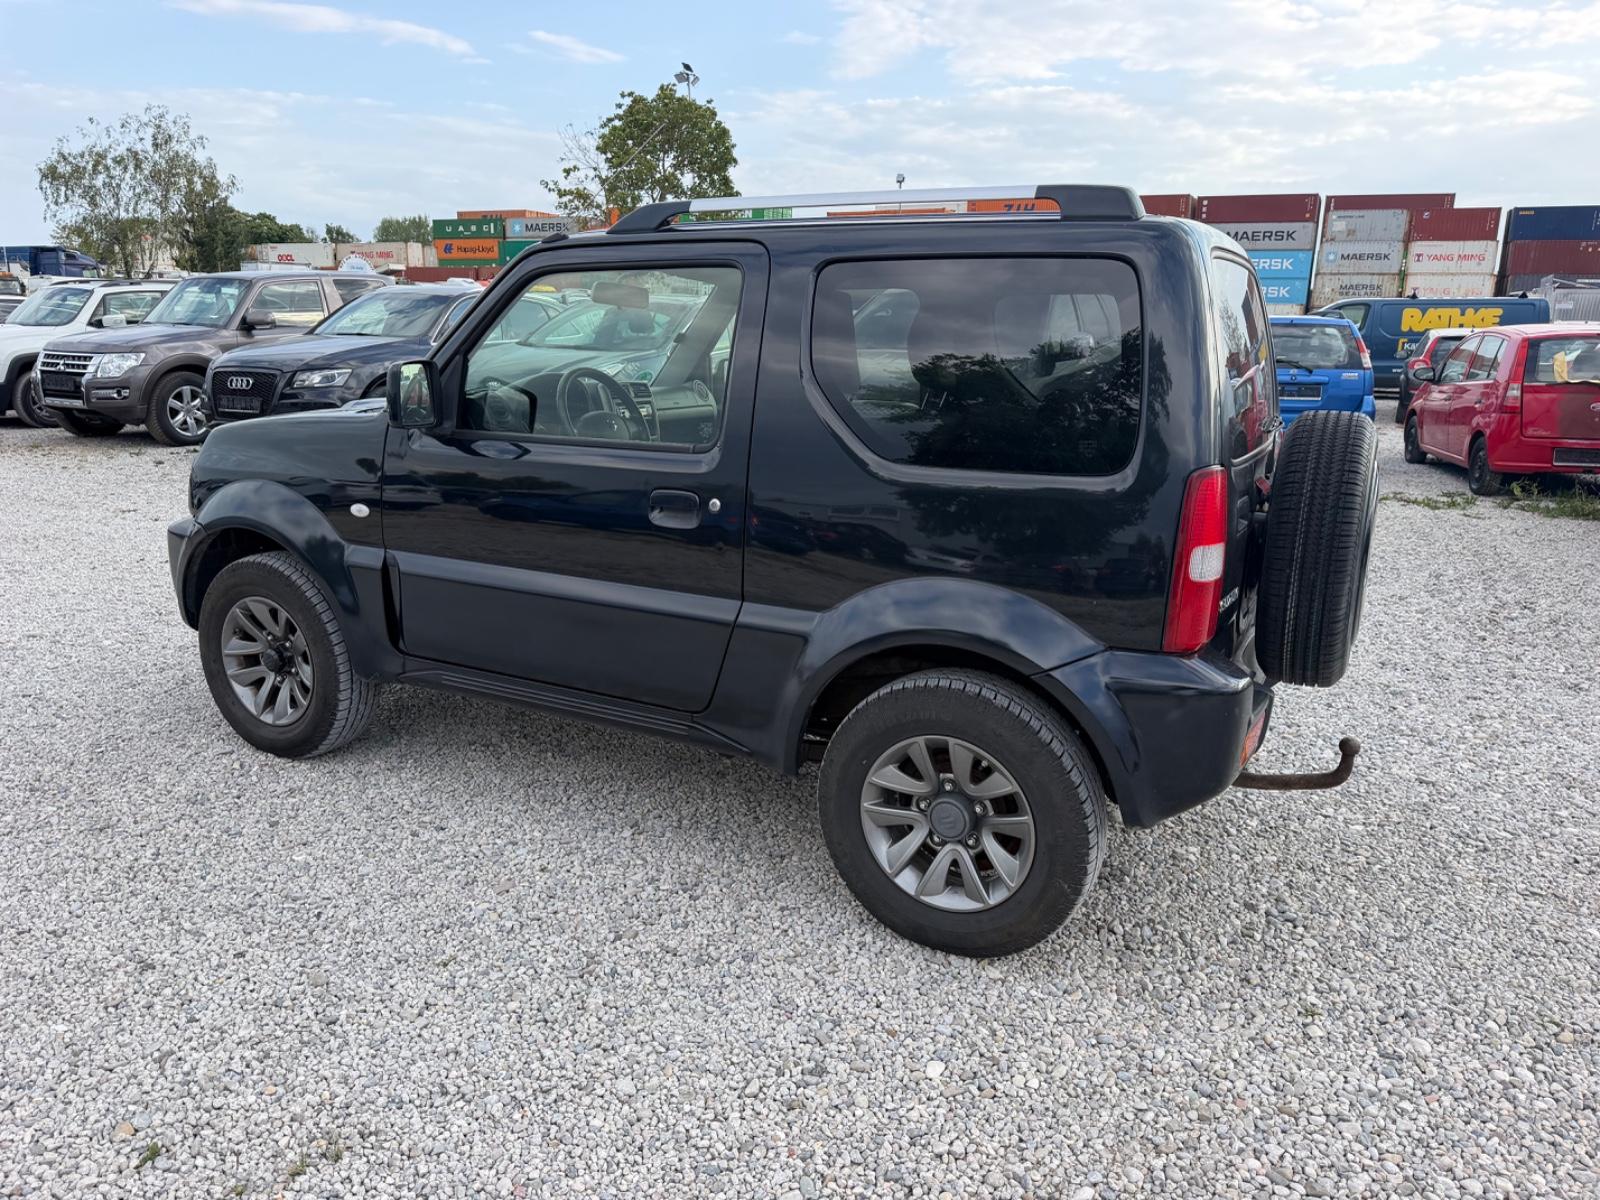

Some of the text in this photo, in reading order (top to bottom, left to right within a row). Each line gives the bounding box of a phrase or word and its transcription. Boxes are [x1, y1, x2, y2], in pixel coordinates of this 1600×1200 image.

[1227, 230, 1297, 242] MAERSK
[457, 246, 495, 254] Hapag-Lloyd
[1340, 252, 1391, 261] MAERSK
[1427, 253, 1486, 262] YANG MING
[1252, 258, 1294, 270] ERSK
[1261, 286, 1290, 298] RSK
[1401, 307, 1503, 332] RATHKE
